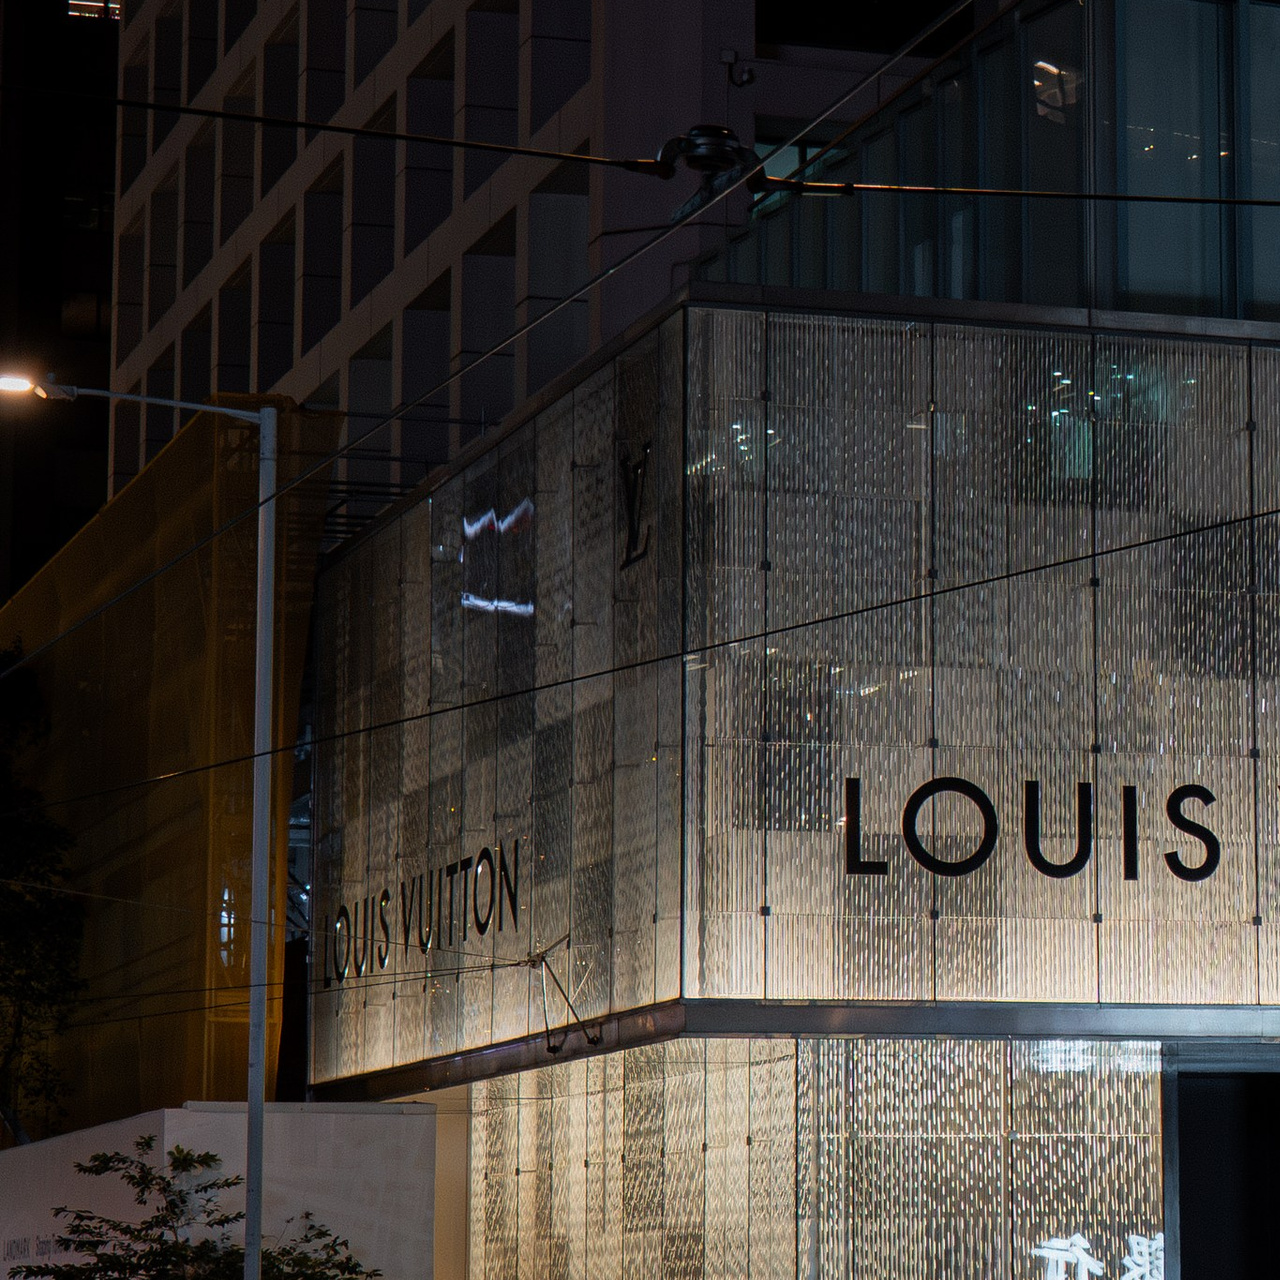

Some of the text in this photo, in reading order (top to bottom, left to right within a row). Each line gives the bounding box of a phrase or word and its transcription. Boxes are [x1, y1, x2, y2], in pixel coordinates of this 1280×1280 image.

[846, 776, 1220, 882] LOUIS
[323, 838, 519, 990] LOUIS VUITTON
